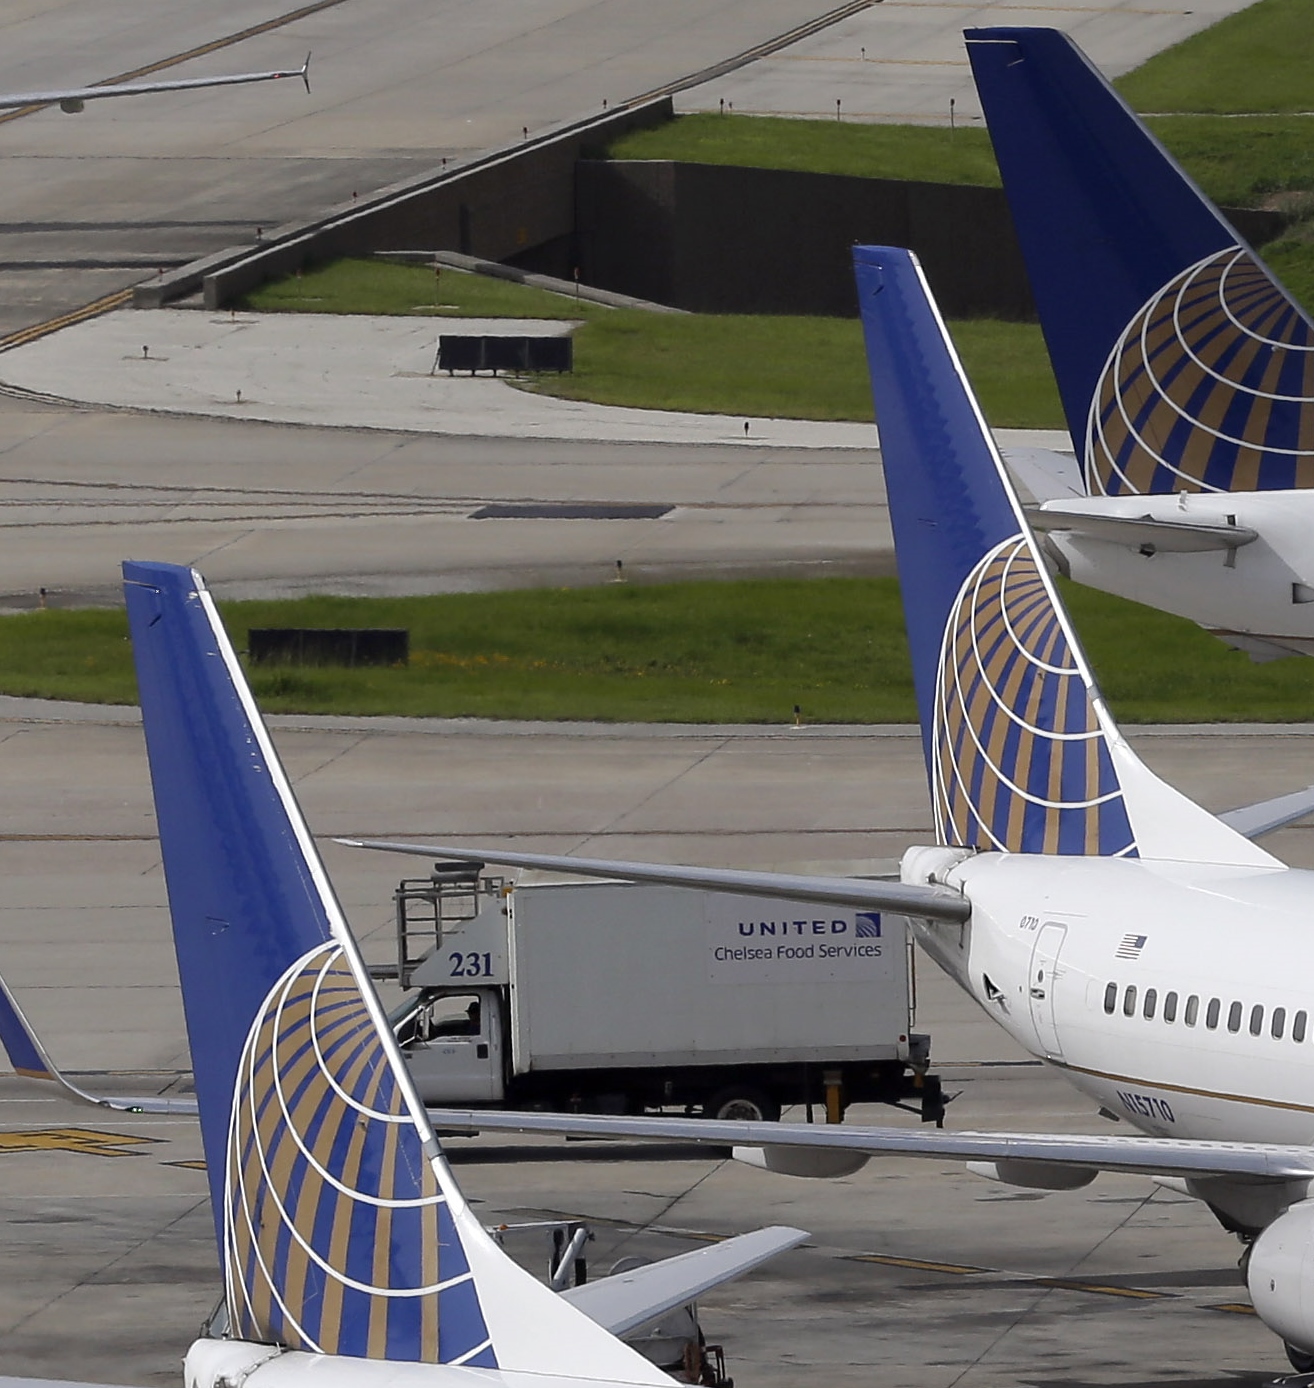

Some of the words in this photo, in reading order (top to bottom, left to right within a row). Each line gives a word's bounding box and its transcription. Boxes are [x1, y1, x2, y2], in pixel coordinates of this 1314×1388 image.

[738, 919, 848, 937] UNITED
[1019, 914, 1039, 931] 0710
[714, 946, 773, 961] Chelsea
[777, 944, 815, 959] Food
[819, 942, 882, 958] Services
[448, 952, 495, 977] 231
[1116, 1090, 1176, 1123] N15710
